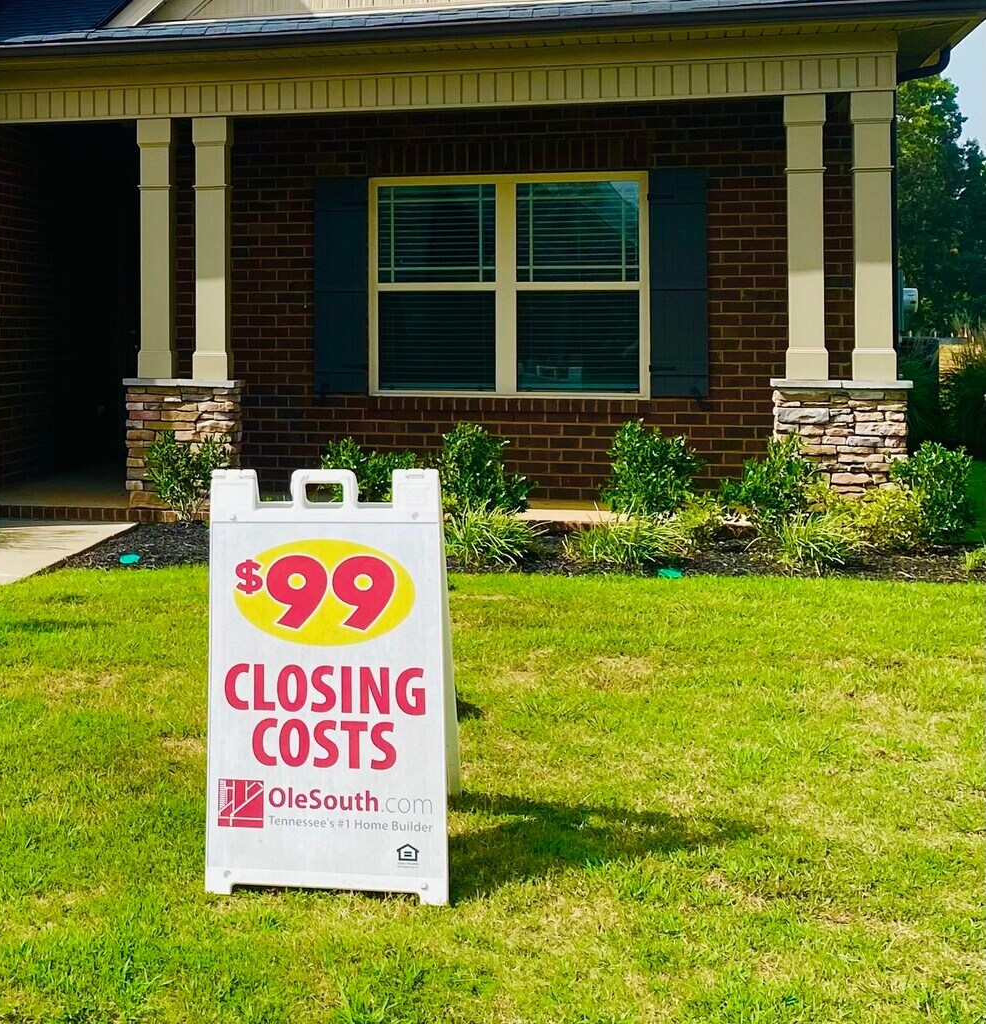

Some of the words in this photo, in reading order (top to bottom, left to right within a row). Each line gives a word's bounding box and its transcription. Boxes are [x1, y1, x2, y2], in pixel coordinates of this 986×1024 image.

[235, 554, 396, 631] $99
[223, 662, 427, 717] CLOSING
[251, 717, 398, 771] COSTS
[268, 787, 434, 815] OleSouth.com
[268, 815, 335, 829] Tennessee's
[337, 819, 351, 830] #1
[354, 819, 389, 831] Home
[391, 820, 434, 833] Builder
